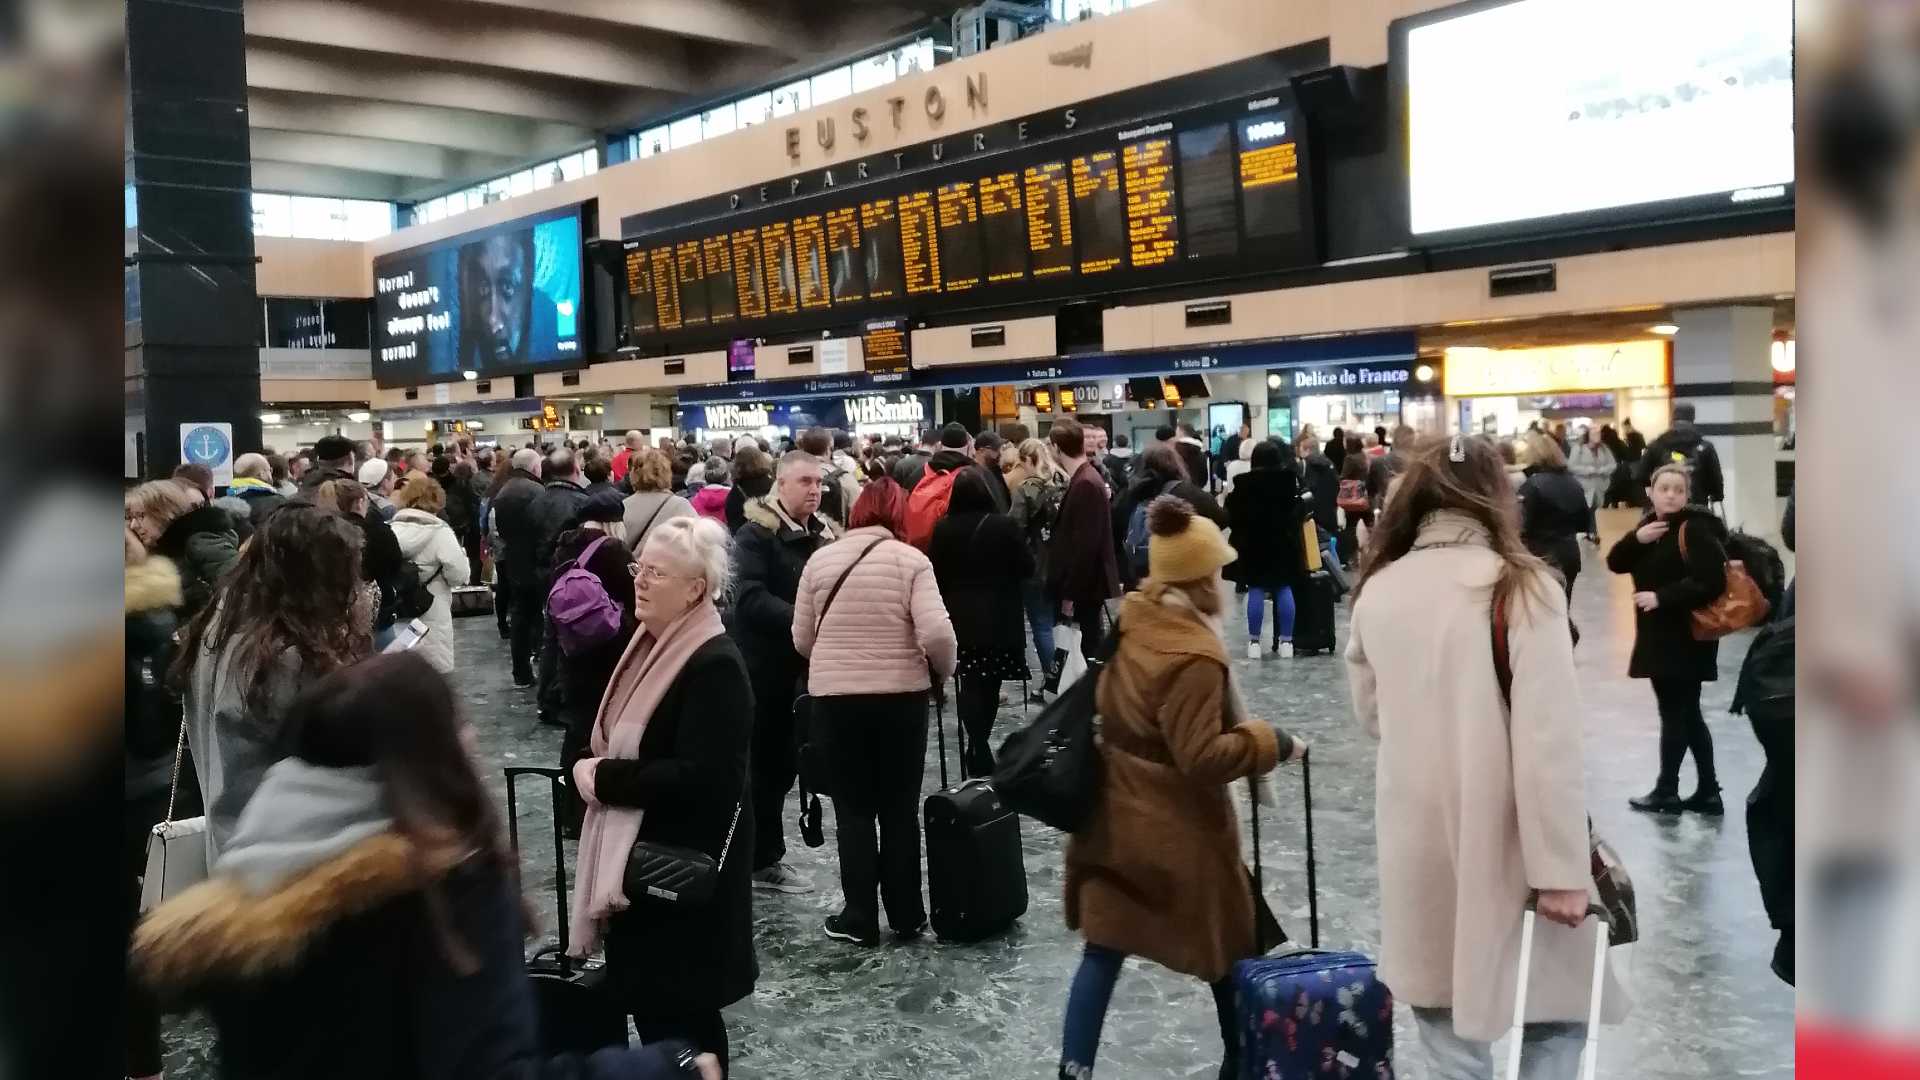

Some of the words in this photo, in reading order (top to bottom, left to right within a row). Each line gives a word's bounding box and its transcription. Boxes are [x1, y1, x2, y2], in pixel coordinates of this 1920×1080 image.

[785, 72, 989, 159] EUSTON
[729, 109, 1077, 209] DEPARTURES
[378, 271, 413, 294] Normal
[399, 286, 439, 310] doesn't
[381, 341, 416, 361] normal
[1295, 370, 1338, 387] Delice
[1339, 368, 1357, 384] de
[1359, 367, 1409, 383] France
[1074, 386, 1085, 401] 10
[1087, 386, 1098, 400] 10
[1114, 384, 1123, 400] 9
[705, 403, 769, 430] WHSmith
[844, 393, 924, 424] WHSmith
